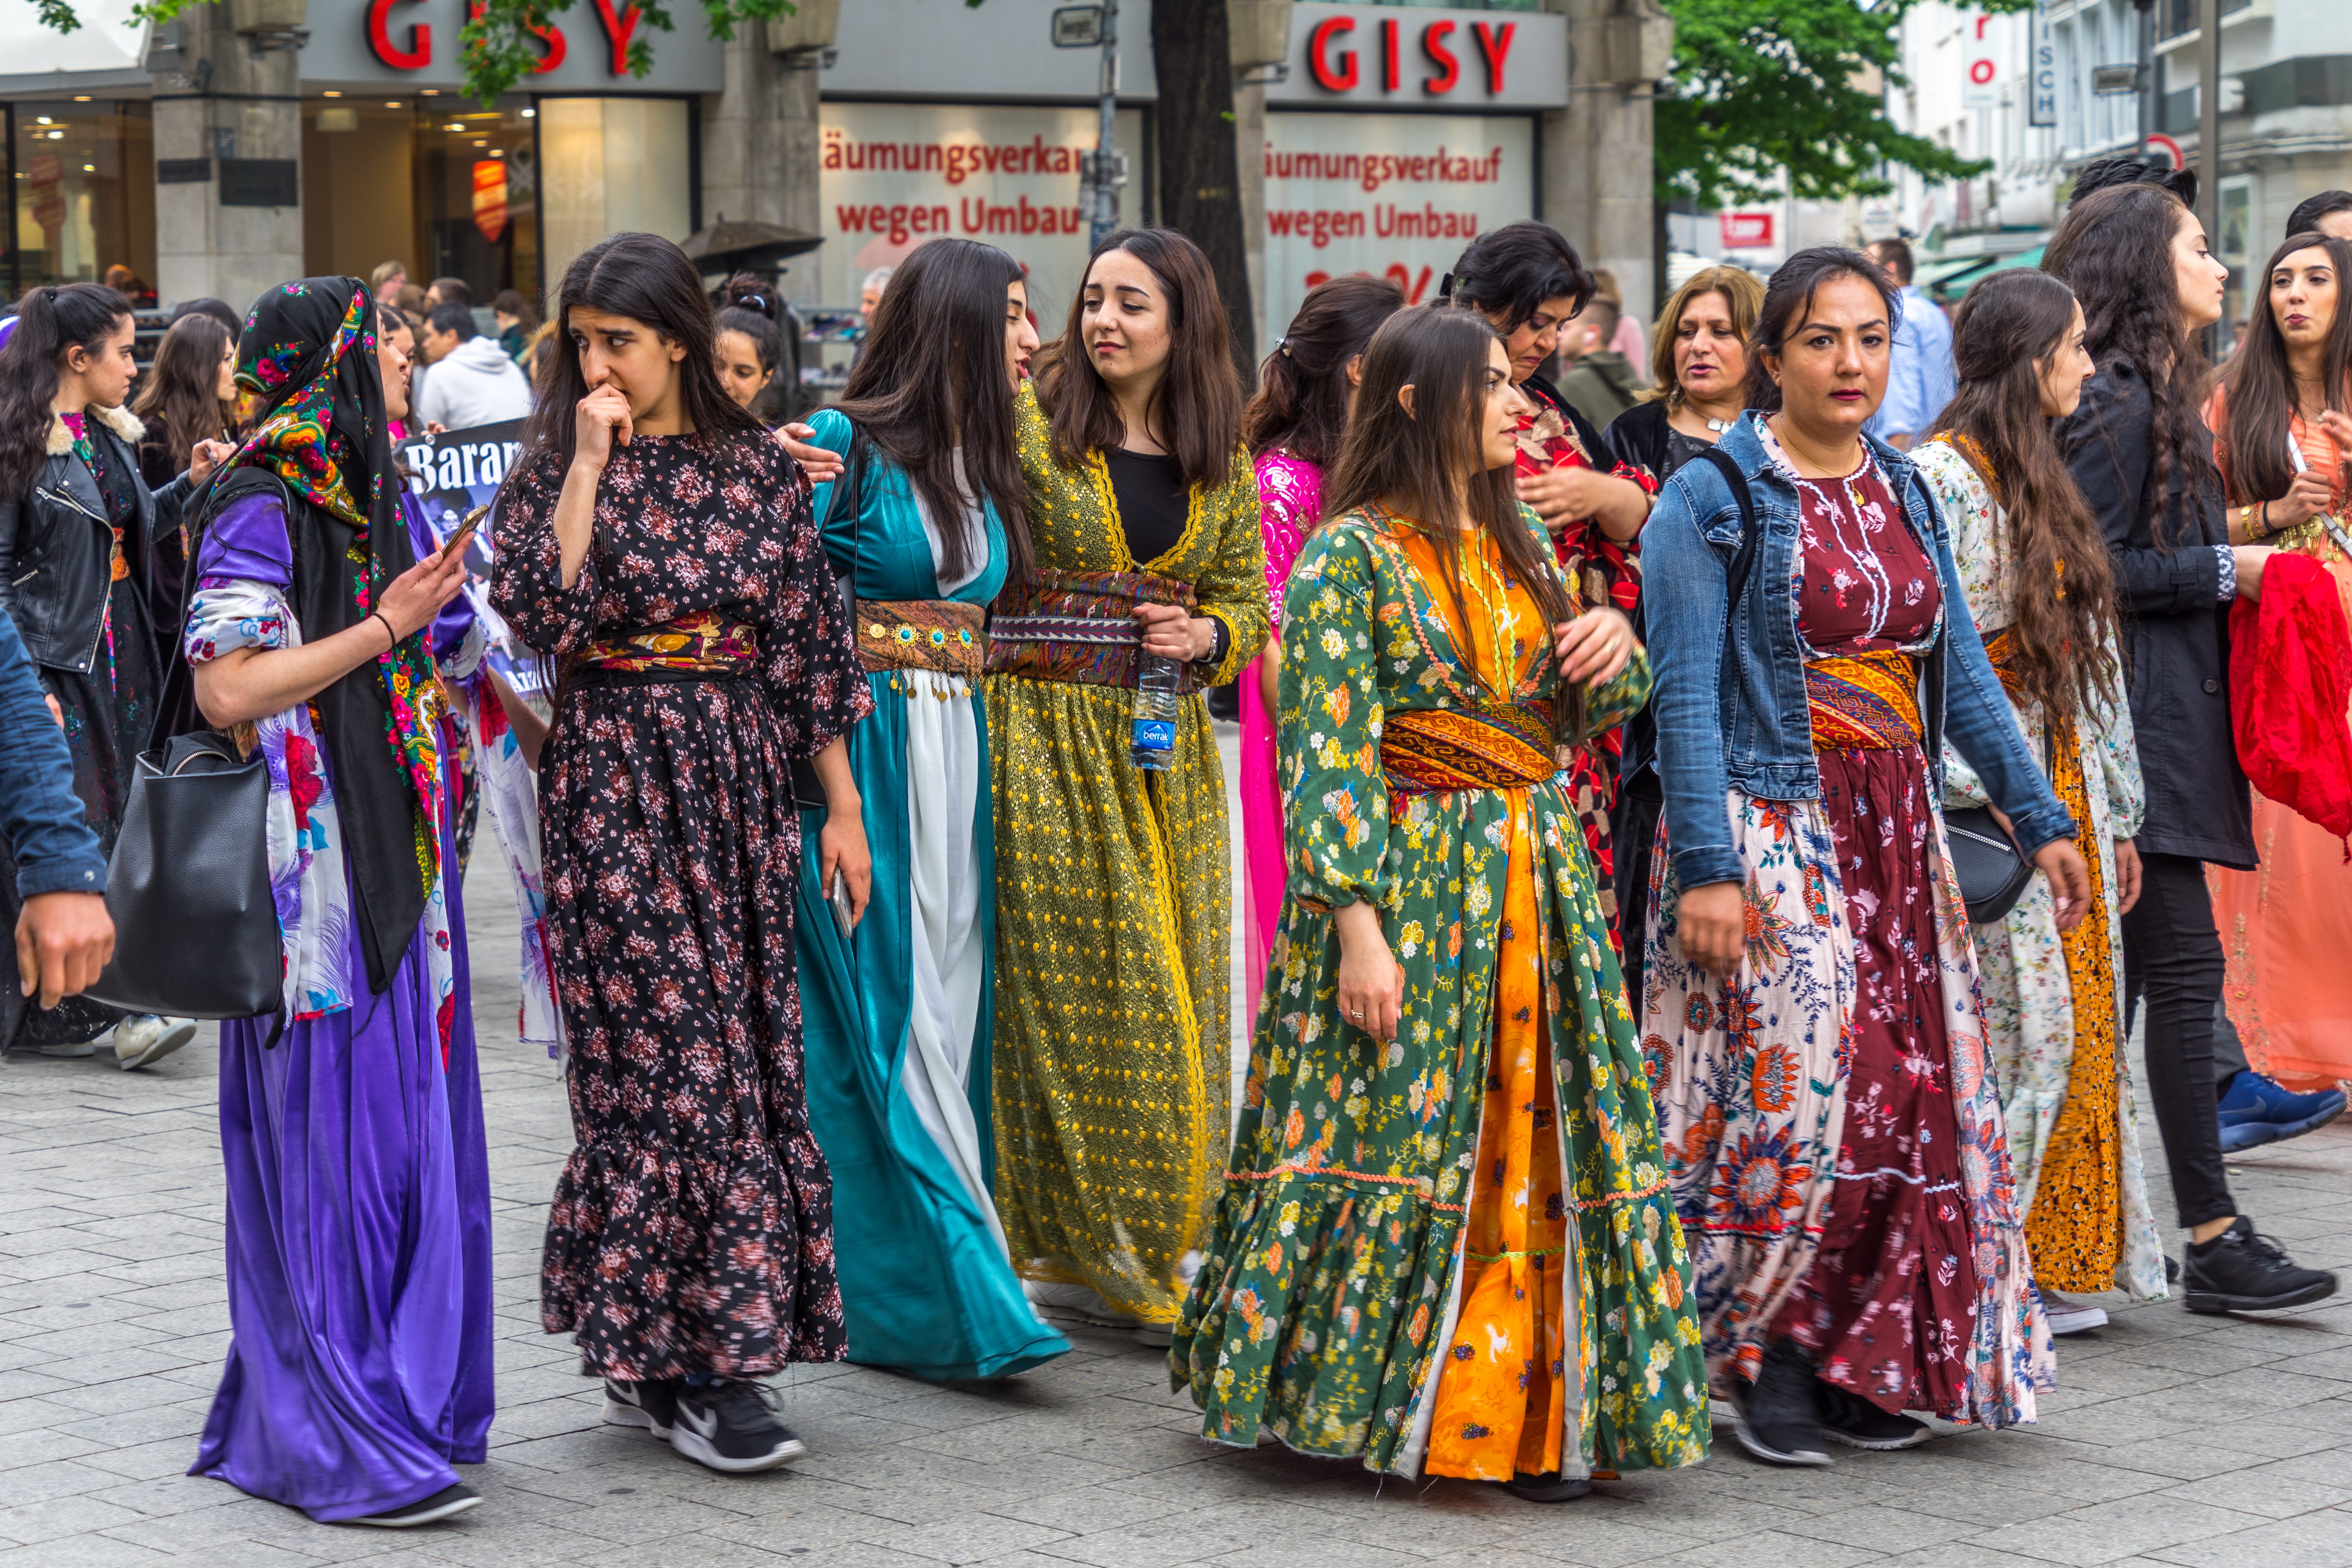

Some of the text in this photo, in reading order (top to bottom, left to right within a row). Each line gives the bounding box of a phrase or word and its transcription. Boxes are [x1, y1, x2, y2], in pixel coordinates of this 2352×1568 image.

[1311, 15, 1517, 94] GISY
[836, 195, 1080, 246] wegen Umbau
[1267, 202, 1477, 248] wegen Umbau
[1143, 730, 1168, 741] berrak
